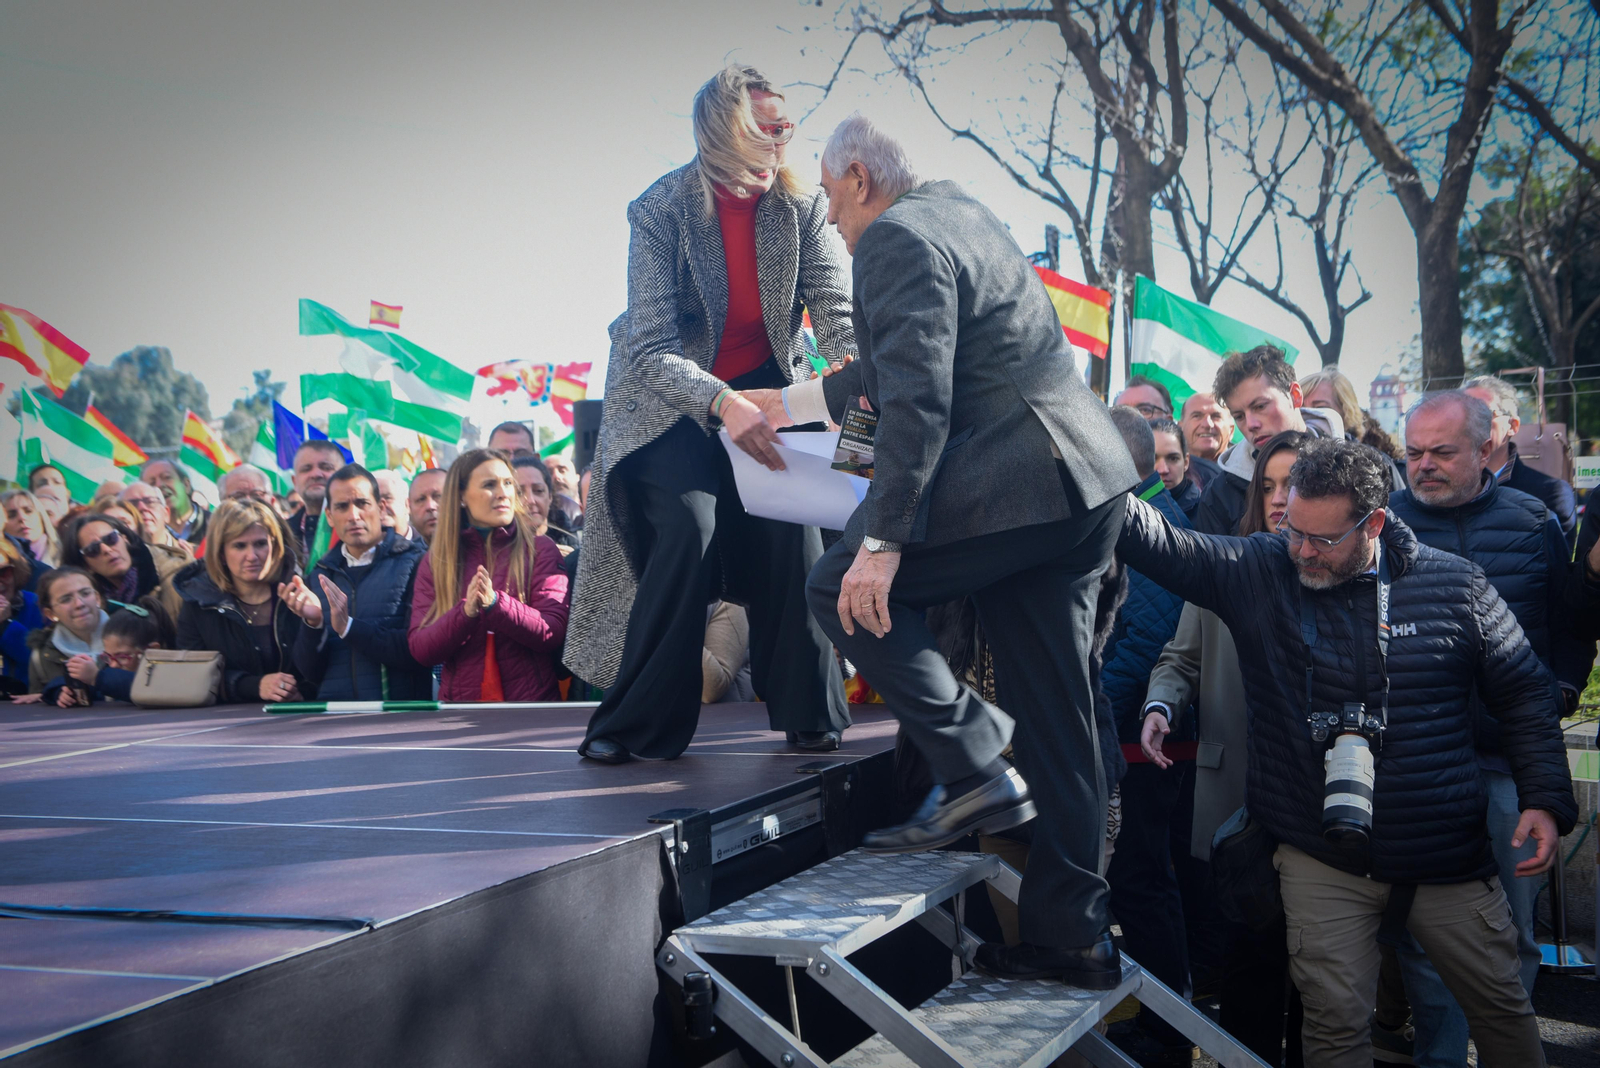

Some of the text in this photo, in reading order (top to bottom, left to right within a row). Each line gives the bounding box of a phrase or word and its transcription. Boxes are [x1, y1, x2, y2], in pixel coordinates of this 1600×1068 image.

[856, 412, 877, 420] DEFENSA
[843, 430, 859, 438] ENTRE
[844, 424, 868, 434] IGUALDAD
[1380, 580, 1389, 622] SONY
[1391, 622, 1417, 637] HH
[750, 827, 783, 846] GUIL
